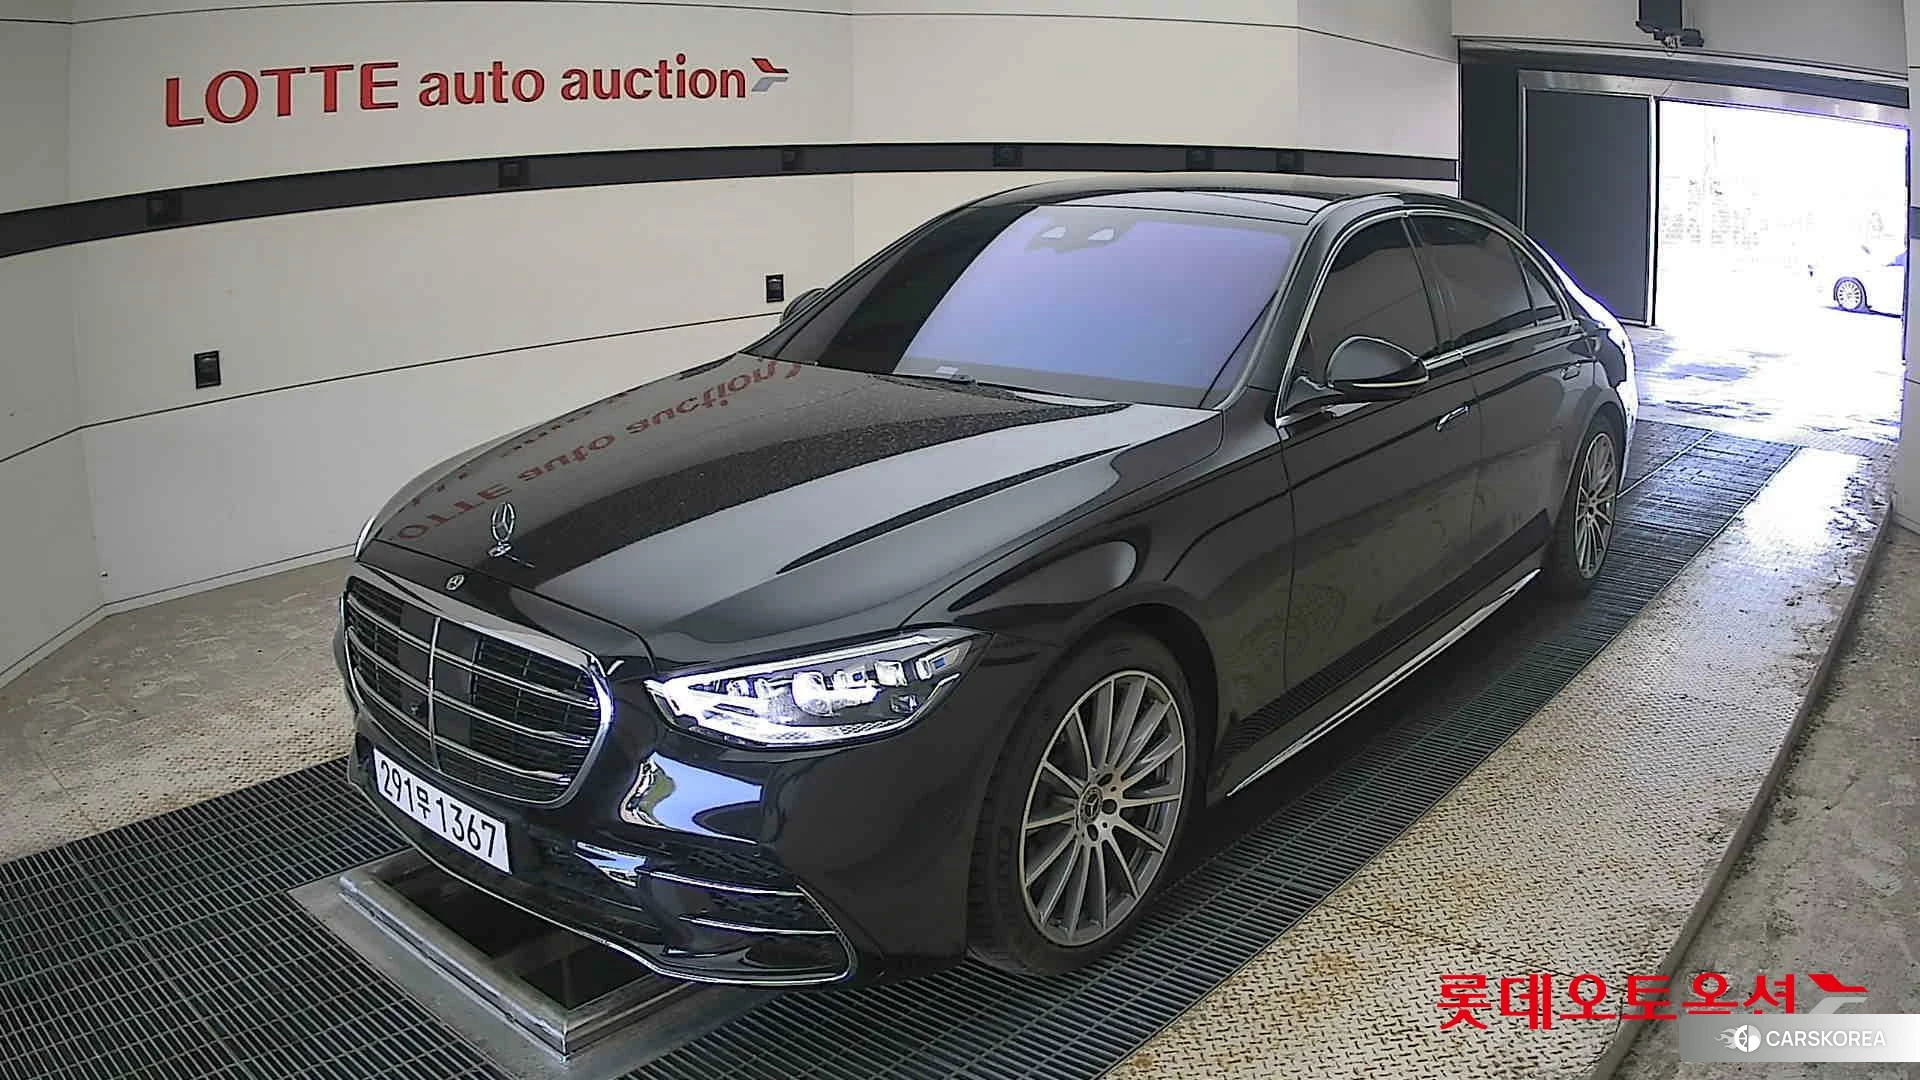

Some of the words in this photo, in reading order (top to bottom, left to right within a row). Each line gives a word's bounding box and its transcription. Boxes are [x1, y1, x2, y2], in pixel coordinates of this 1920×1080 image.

[165, 61, 400, 128] LOTTE
[418, 60, 545, 108] auto
[560, 53, 747, 101] auction
